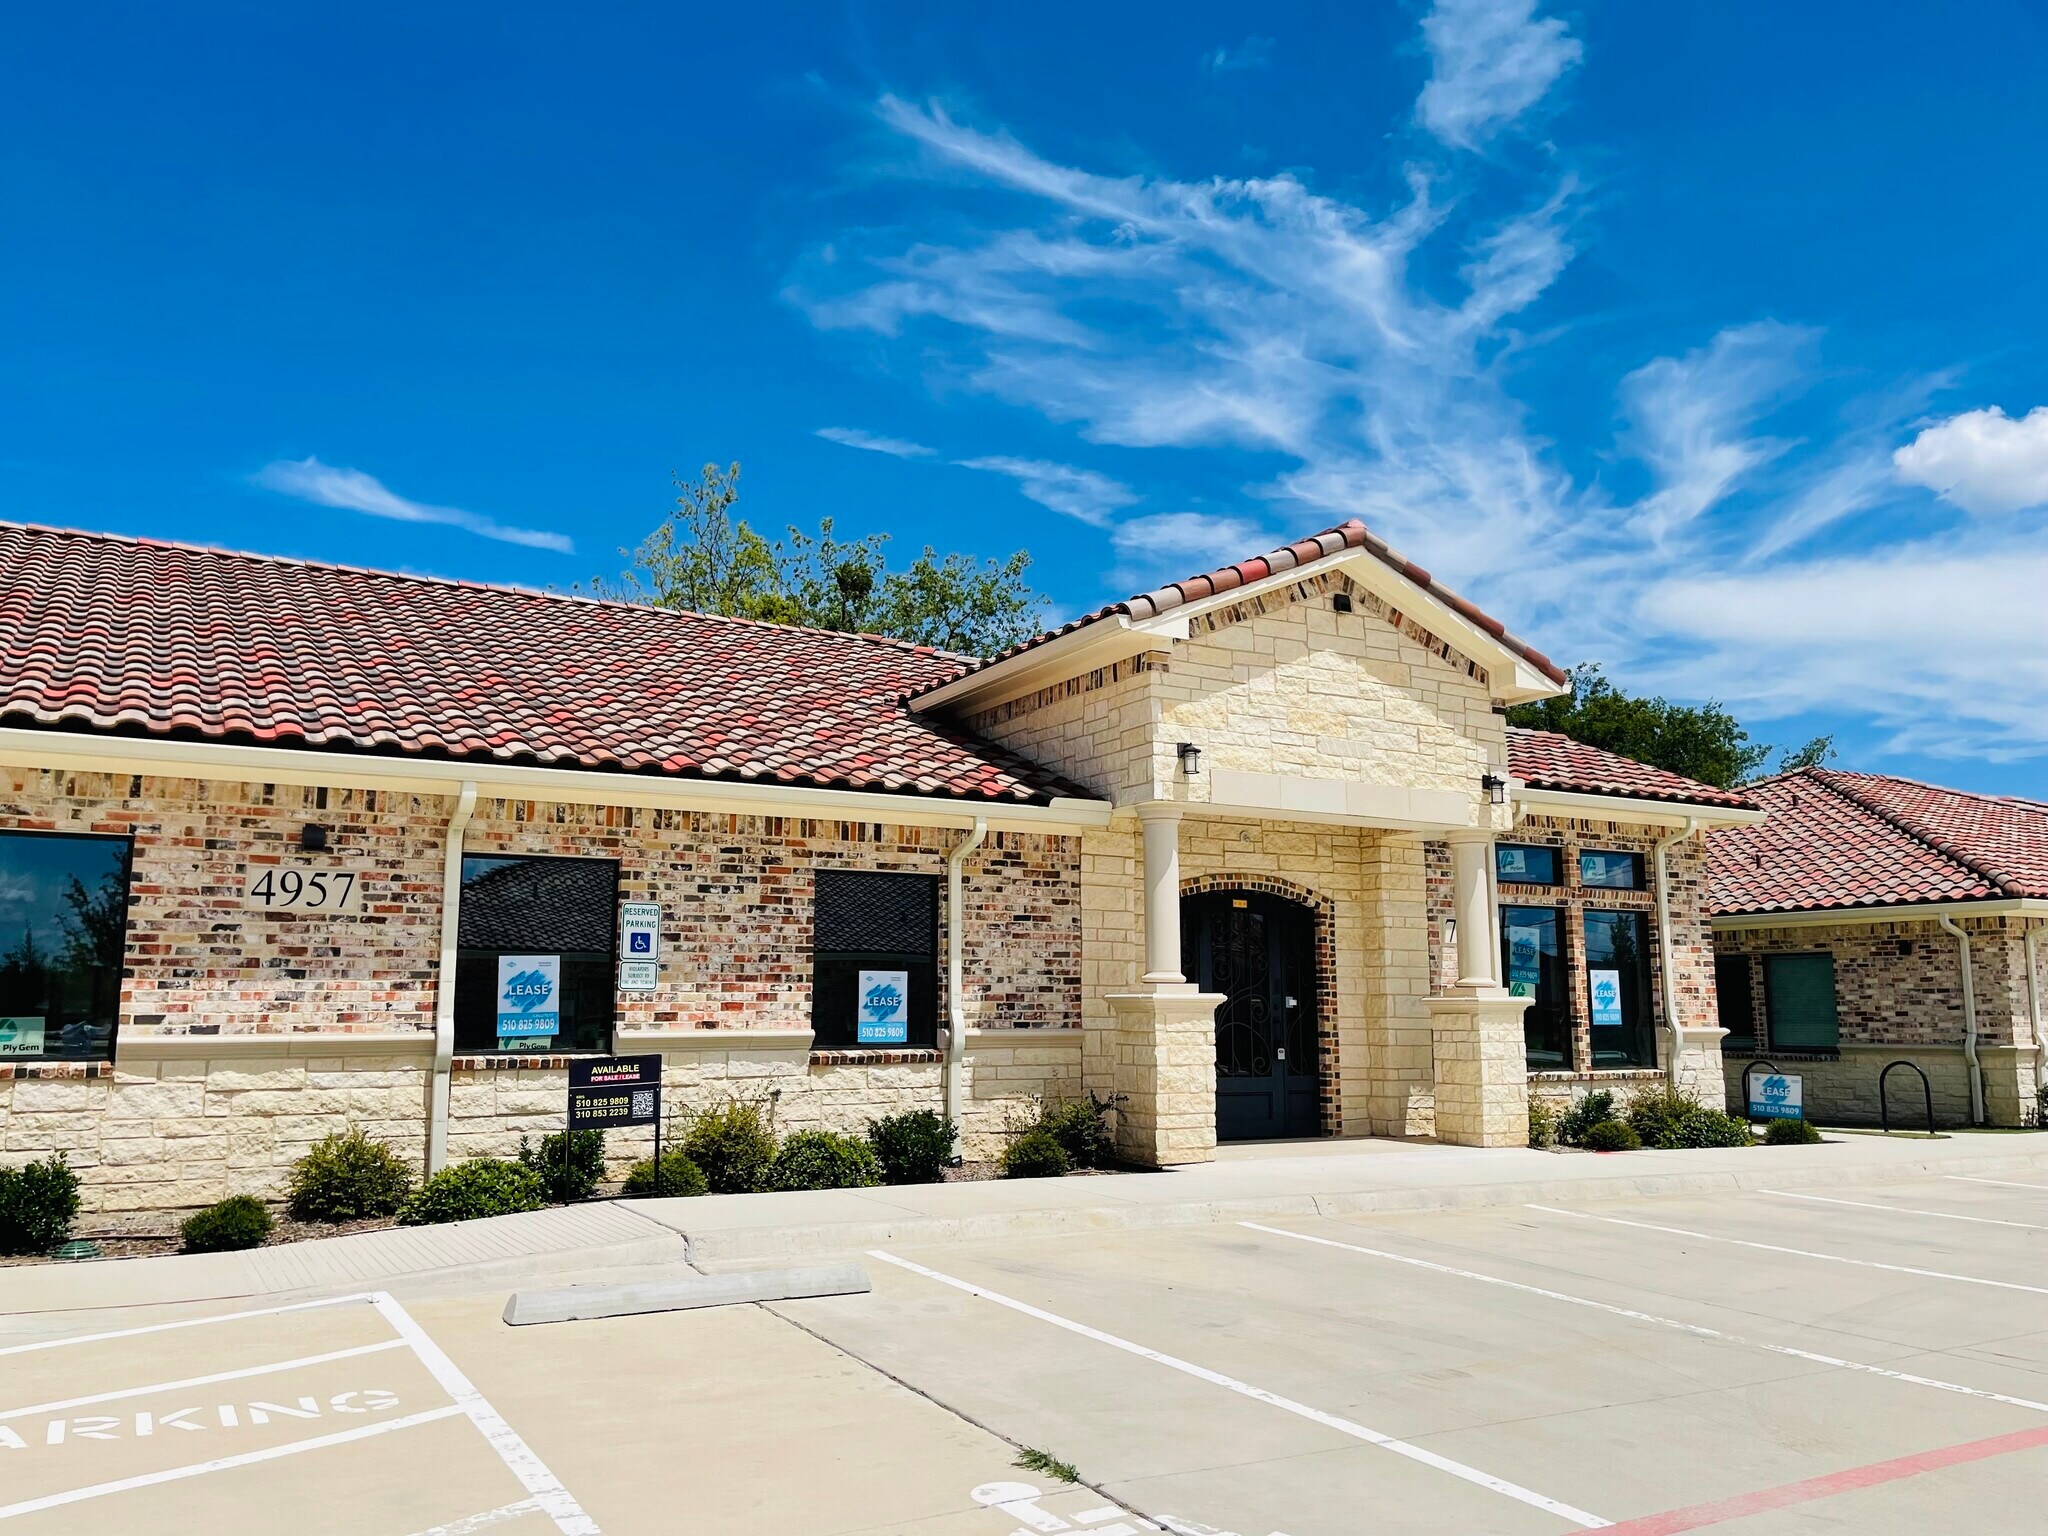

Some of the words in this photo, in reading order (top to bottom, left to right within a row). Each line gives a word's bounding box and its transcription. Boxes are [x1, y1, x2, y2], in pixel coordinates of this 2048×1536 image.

[251, 870, 356, 908] 4957
[624, 907, 659, 917] RESERVED
[625, 919, 656, 929] PARKING
[1514, 946, 1536, 956] LEASE
[508, 984, 549, 996] LEASE
[1596, 990, 1616, 998] LEASE
[867, 996, 899, 1007] LEASE
[502, 1019, 517, 1031] 510
[518, 1019, 533, 1030] 825
[534, 1018, 555, 1030] 9809
[862, 1027, 874, 1037] 510
[874, 1027, 887, 1037] 825
[887, 1027, 904, 1037] 9809
[2, 1044, 17, 1054] Ply
[18, 1043, 40, 1051] Gem
[519, 1042, 530, 1050] Ply
[531, 1042, 548, 1050] Gem
[591, 1064, 640, 1075] AVAILABLE
[1761, 1087, 1790, 1097] LEASE
[575, 1099, 591, 1108] 510
[592, 1098, 608, 1106] 825
[609, 1096, 629, 1106] 9809
[575, 1110, 591, 1119] 310
[592, 1109, 608, 1118] 853
[608, 1107, 629, 1117] 2239
[1752, 1104, 1765, 1112] 510
[1766, 1105, 1779, 1113] 825
[1780, 1106, 1800, 1115] 9809
